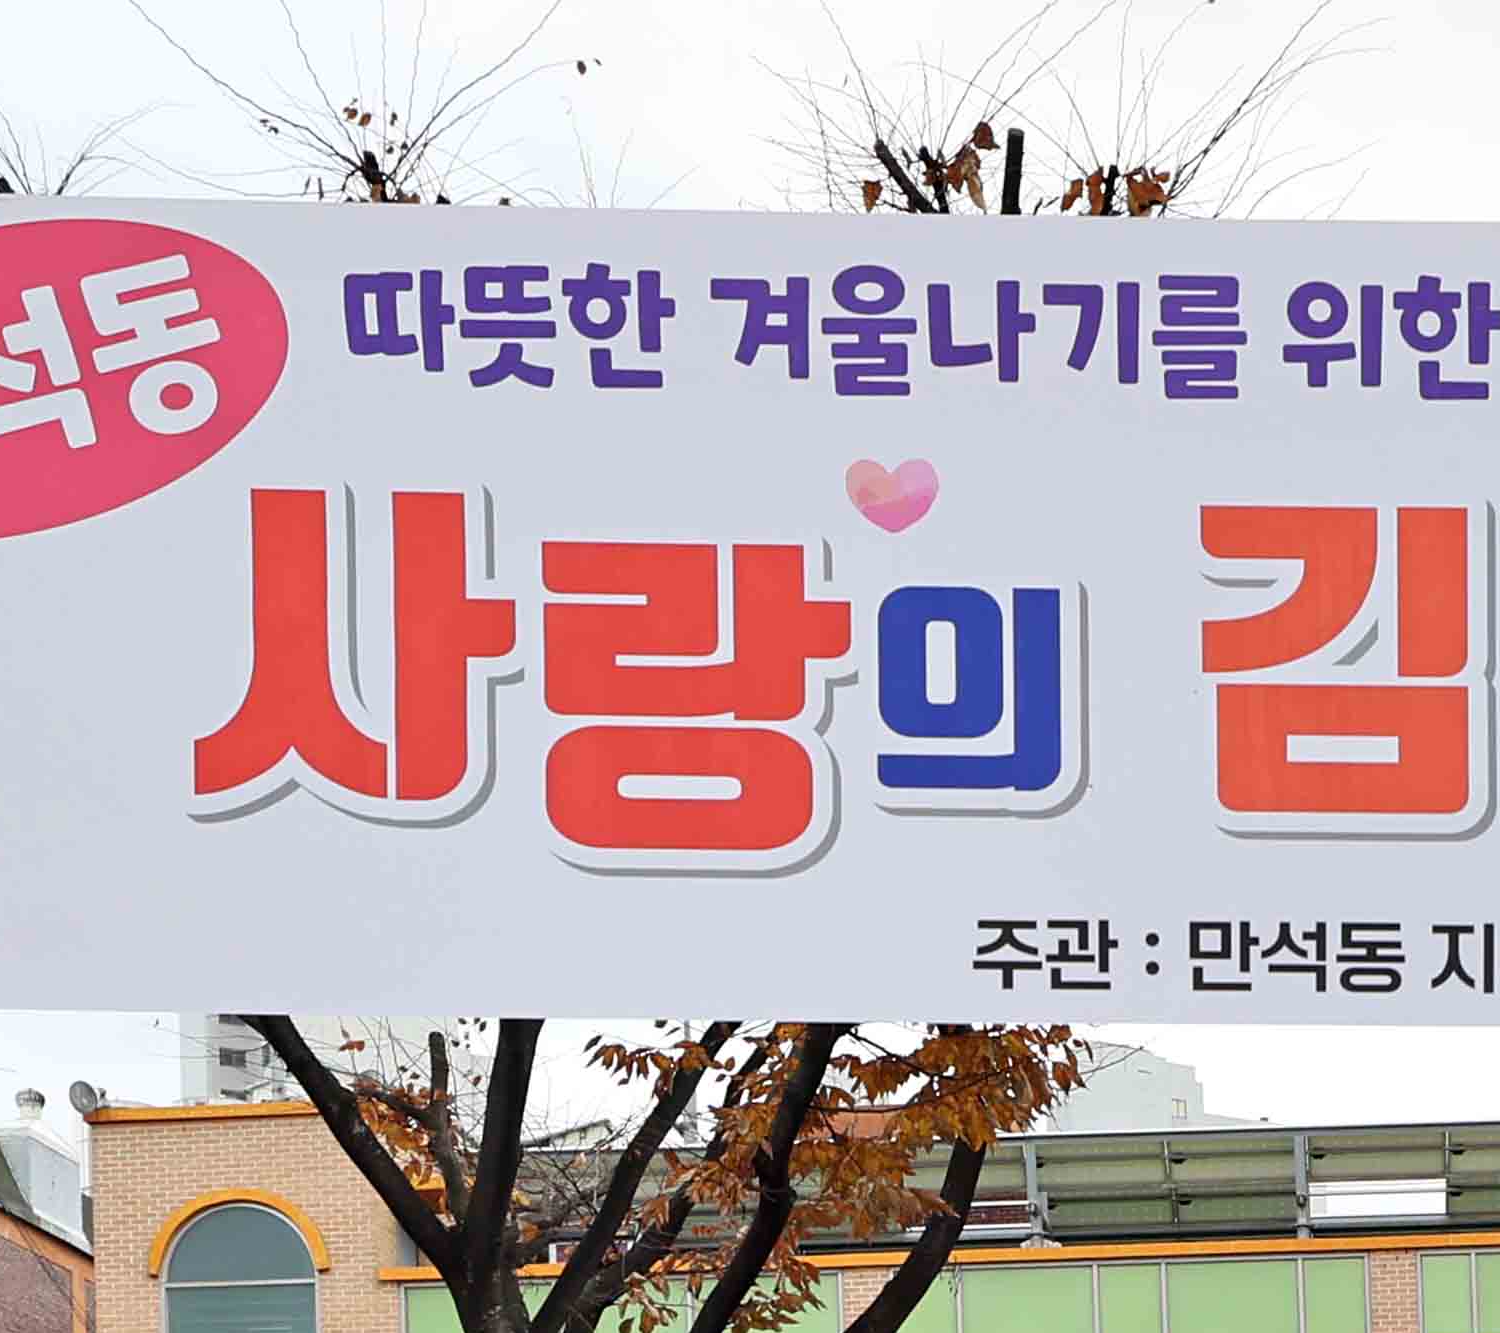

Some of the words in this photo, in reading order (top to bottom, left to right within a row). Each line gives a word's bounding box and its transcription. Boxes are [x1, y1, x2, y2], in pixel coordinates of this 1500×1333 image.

[344, 263, 676, 388] 따뜻한
[711, 266, 1247, 399] 겨울나기를
[192, 487, 1062, 850] 사랑의
[972, 919, 1119, 990] 주관
[1189, 921, 1406, 993] 만석동
